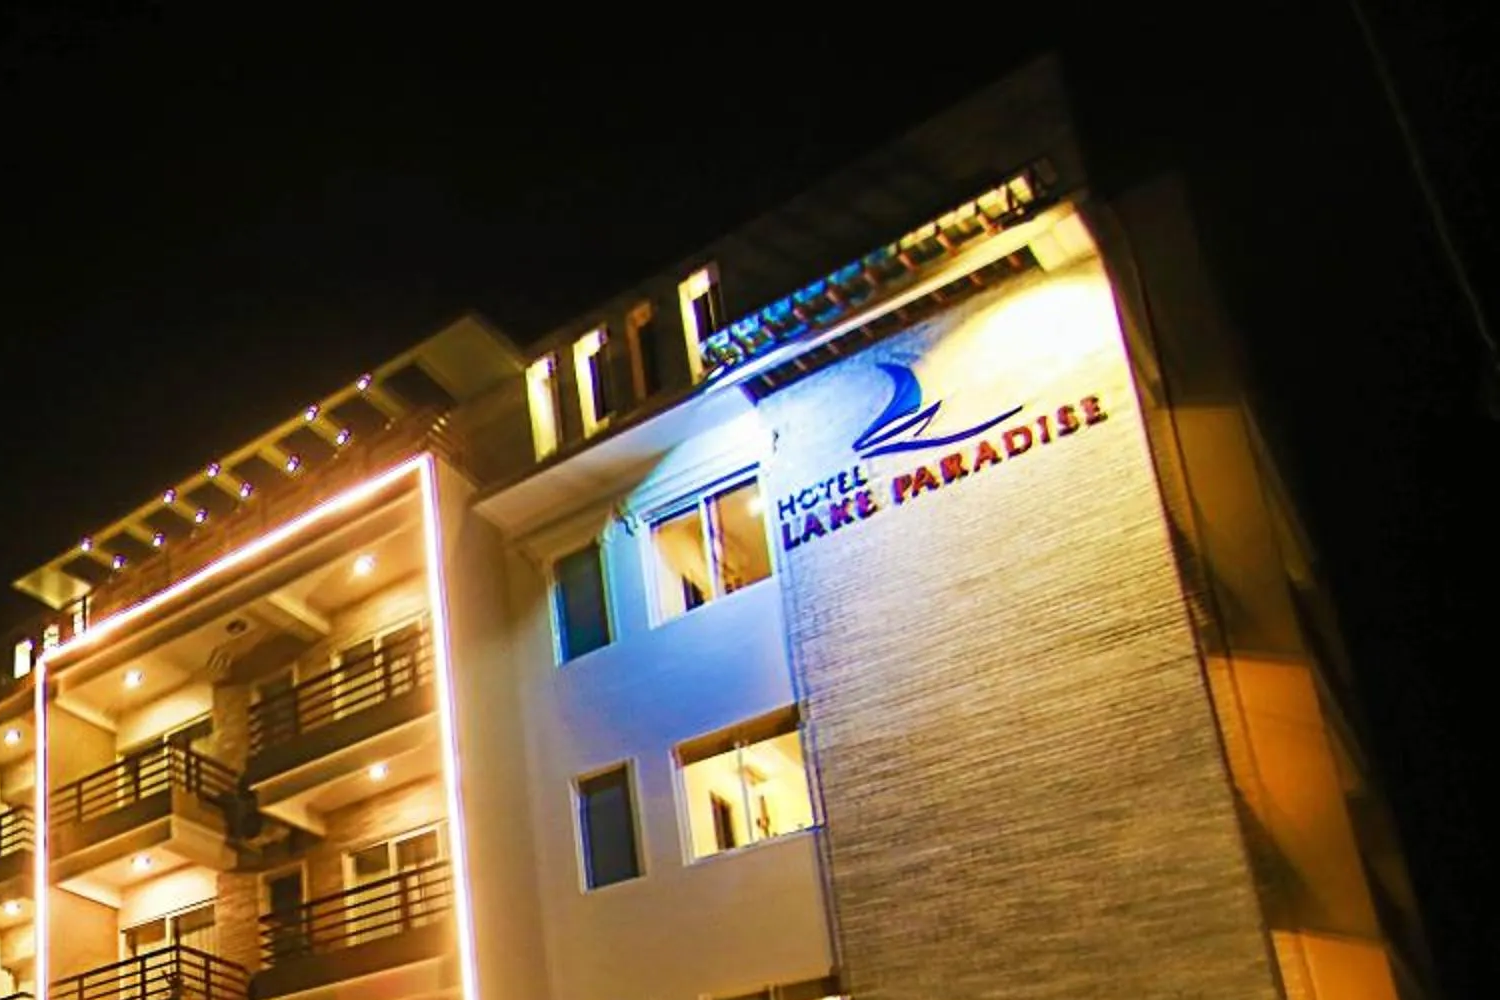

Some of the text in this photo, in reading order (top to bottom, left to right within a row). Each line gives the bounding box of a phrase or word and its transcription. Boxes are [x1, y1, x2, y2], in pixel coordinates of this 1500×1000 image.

[777, 465, 869, 521] HOTEL
[781, 394, 1109, 552] LAKE PARADISE
